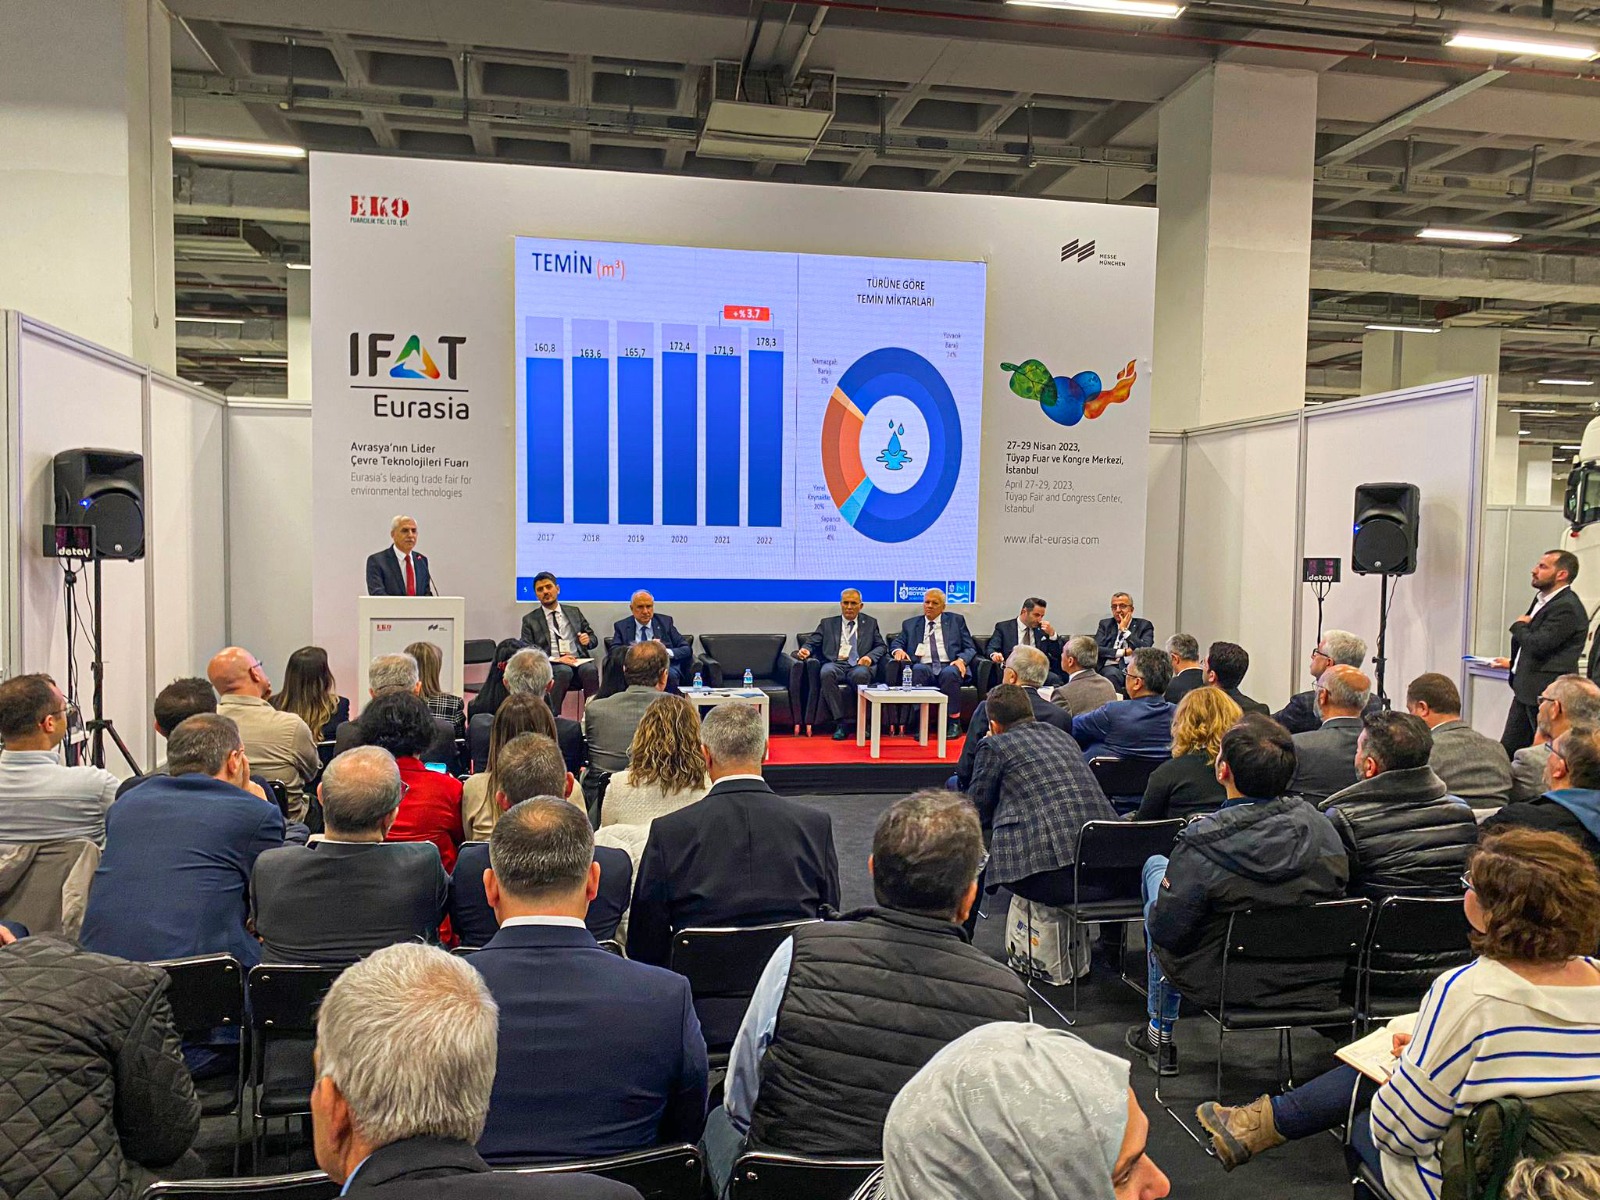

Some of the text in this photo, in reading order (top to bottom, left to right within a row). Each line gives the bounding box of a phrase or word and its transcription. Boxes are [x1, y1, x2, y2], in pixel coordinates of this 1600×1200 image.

[350, 195, 410, 218] EKO
[532, 250, 592, 274] TEMİN
[867, 277, 926, 290] TÜRÜNE GÖRE
[857, 292, 935, 306] TEMİN MİKTARLARI
[670, 341, 691, 351] 172,4
[756, 337, 777, 347] 178,3
[534, 343, 556, 353] 160,8
[625, 347, 646, 359] 165,7
[713, 346, 734, 356] 171,9
[580, 349, 602, 359] 163,6
[374, 394, 469, 420] Eurasia
[411, 443, 436, 453] Lider
[1006, 441, 1080, 452] 27-29 Nisan 2023,
[350, 455, 469, 469] Çevre Teknolojileri Fuarı
[1006, 453, 1124, 466] Tüyap Fuar ve Kongre Merkezi,
[1005, 463, 1039, 475] İstanbul
[351, 472, 472, 485] Eurasia's leading trade fair for
[1005, 480, 1075, 491] April 27-29, 2023,
[351, 486, 463, 500] environmental technologies
[1005, 491, 1027, 502] Tüyap
[1029, 493, 1044, 501] Fair
[1045, 493, 1060, 502] and
[1061, 493, 1096, 504] Congress
[537, 533, 555, 542] 2017
[582, 533, 600, 542] 2018
[627, 534, 645, 543] 2019
[671, 535, 688, 544] 2020
[714, 536, 731, 544] 2021
[756, 536, 773, 545] 2022
[1003, 534, 1100, 544] www.ifat-eurasia.com
[58, 547, 91, 557] detay
